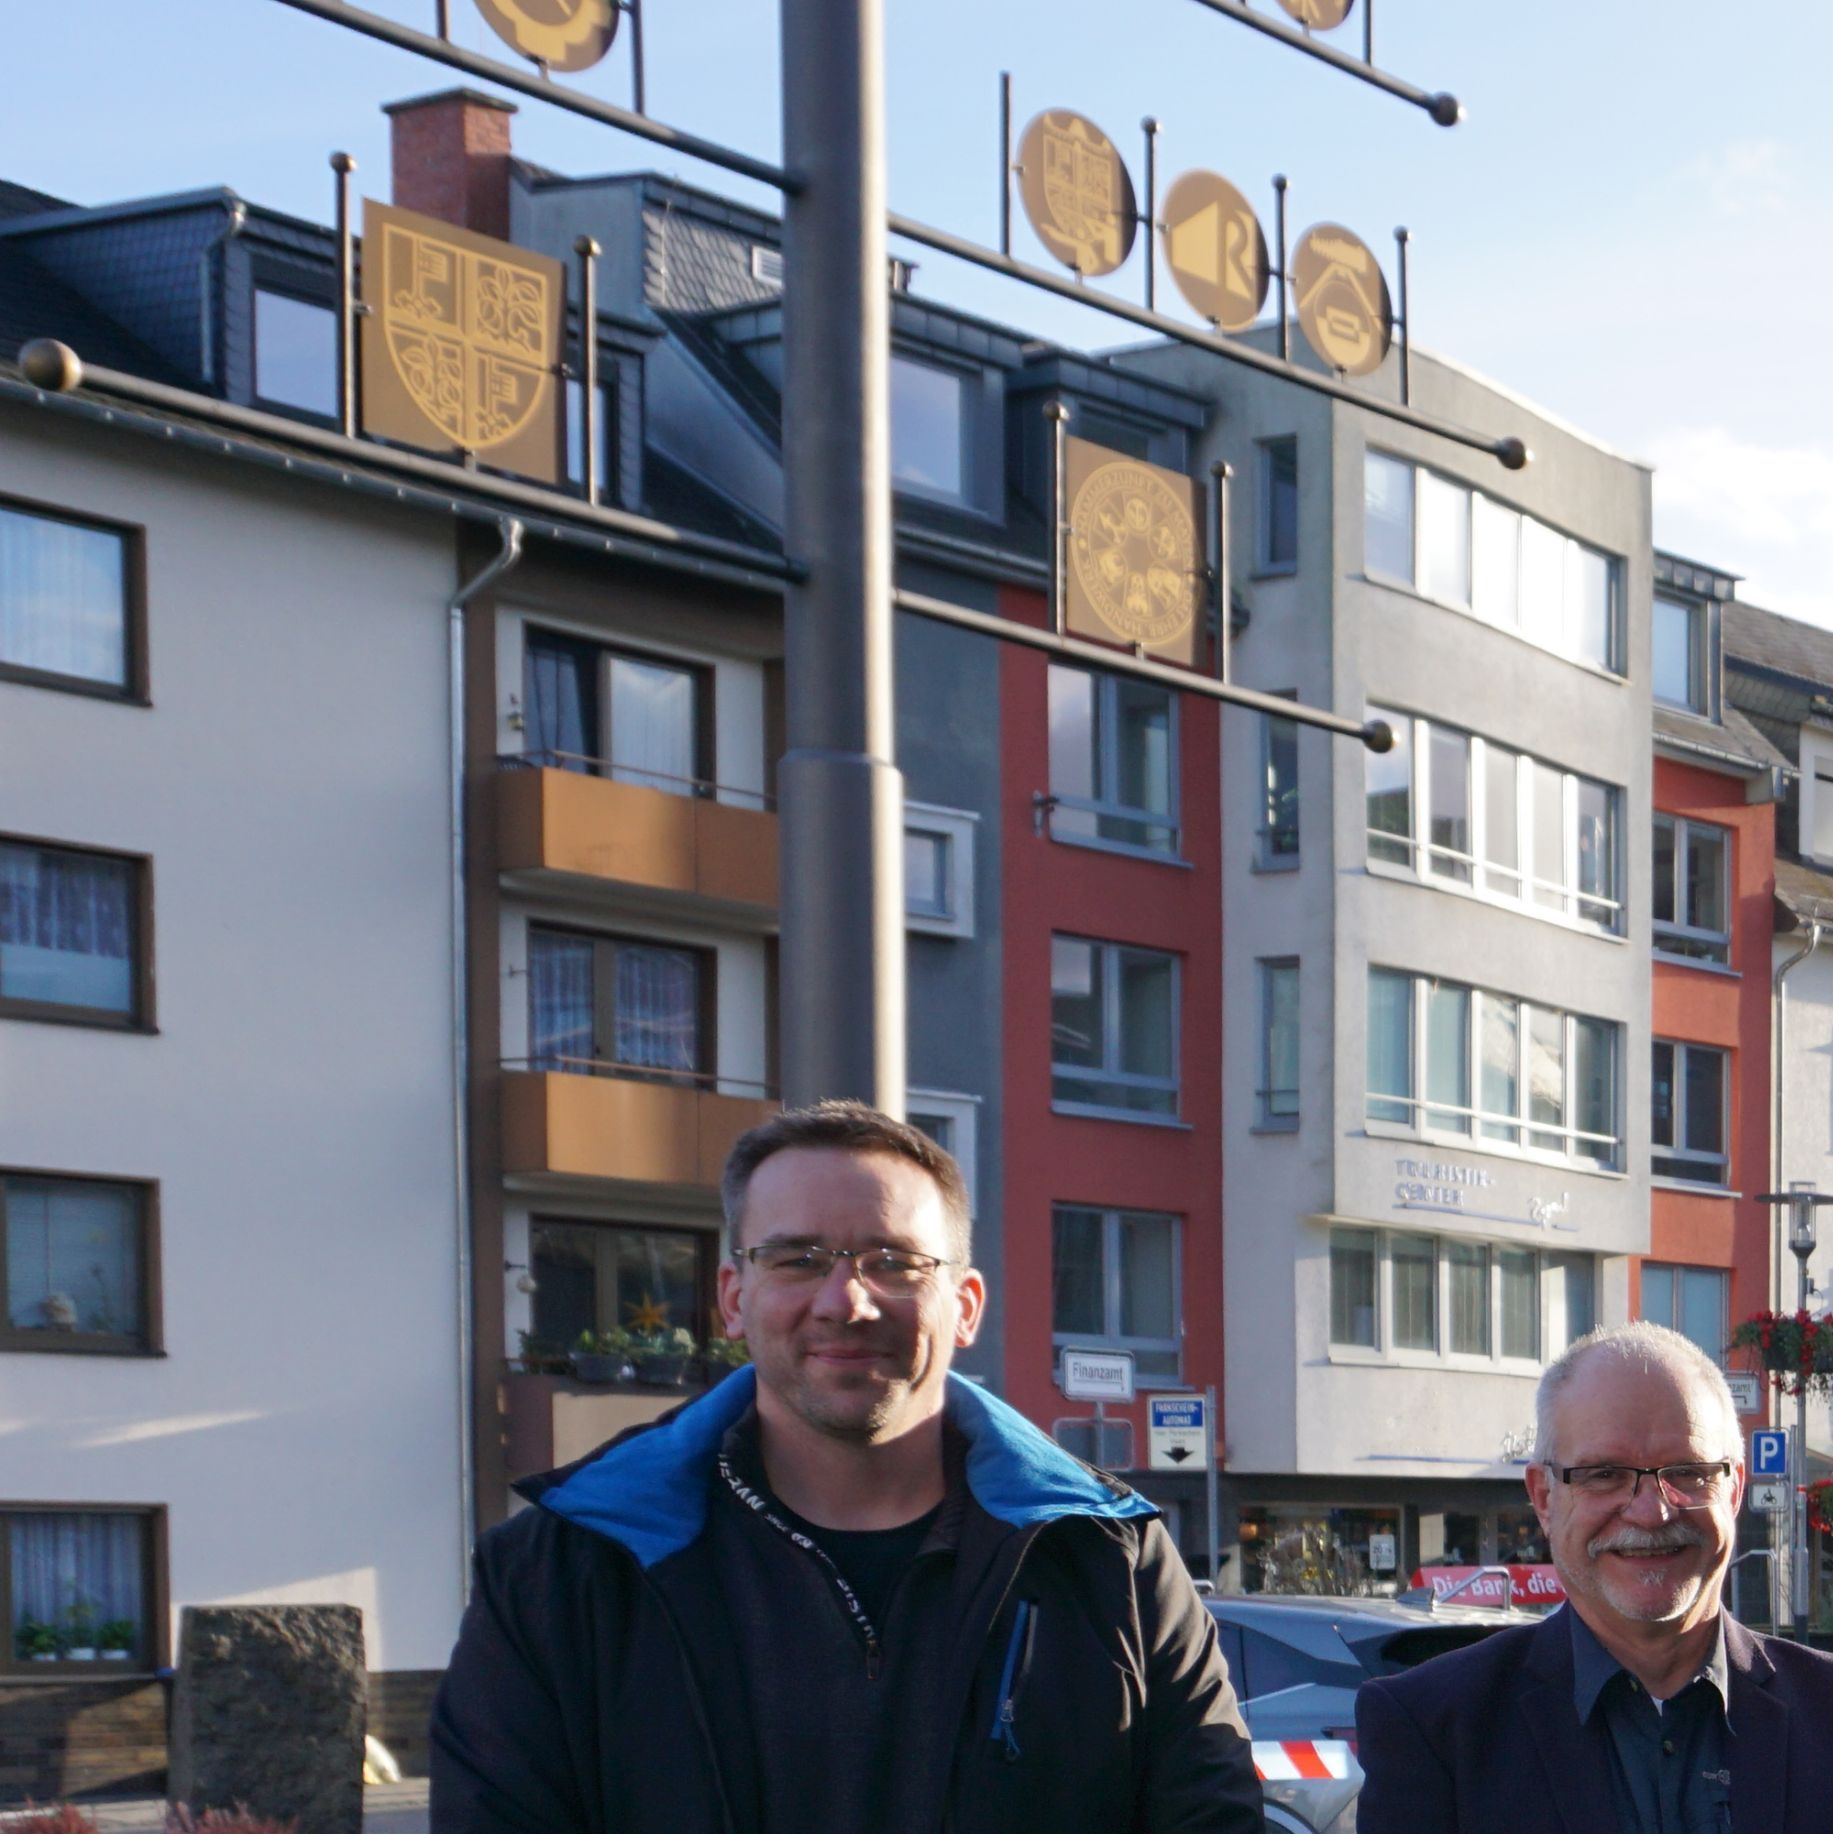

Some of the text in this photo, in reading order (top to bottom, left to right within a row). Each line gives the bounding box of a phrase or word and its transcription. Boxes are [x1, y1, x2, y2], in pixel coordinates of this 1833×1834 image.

[1073, 1362, 1123, 1380] Finanzamt
[1760, 1436, 1778, 1470] P
[1527, 1571, 1558, 1594] die
